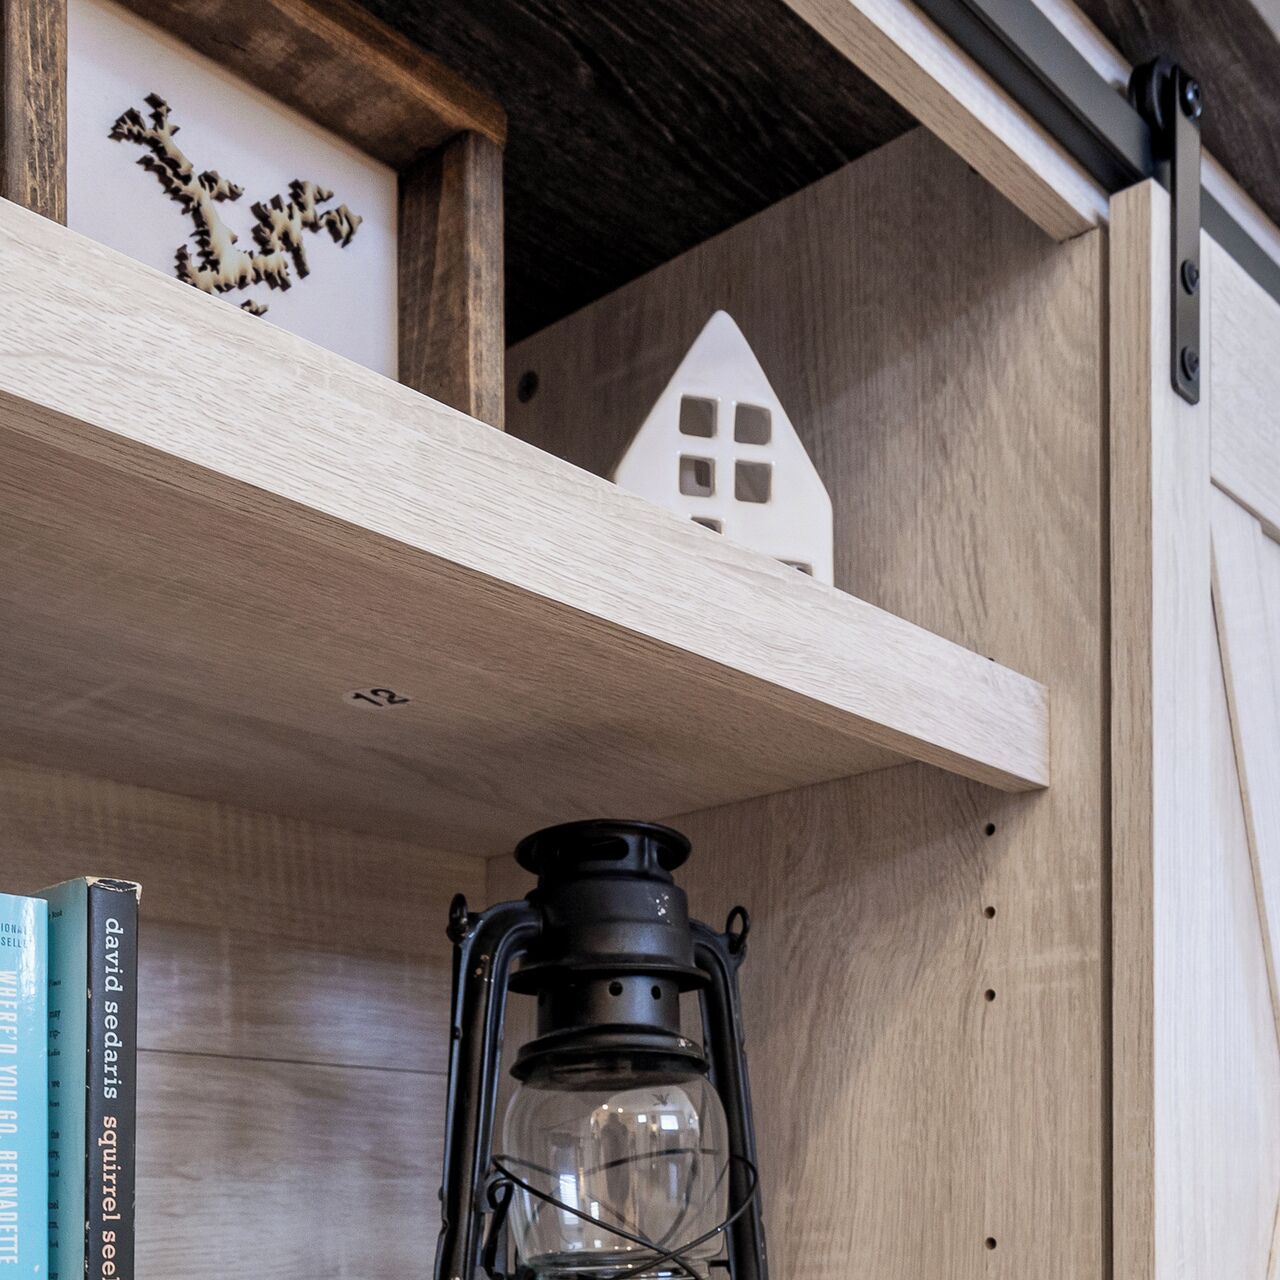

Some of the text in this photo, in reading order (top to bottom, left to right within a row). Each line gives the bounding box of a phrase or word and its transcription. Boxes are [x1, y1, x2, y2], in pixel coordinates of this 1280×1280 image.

[103, 916, 124, 1099] david sedaris
[98, 1115, 122, 1221] squirrel
